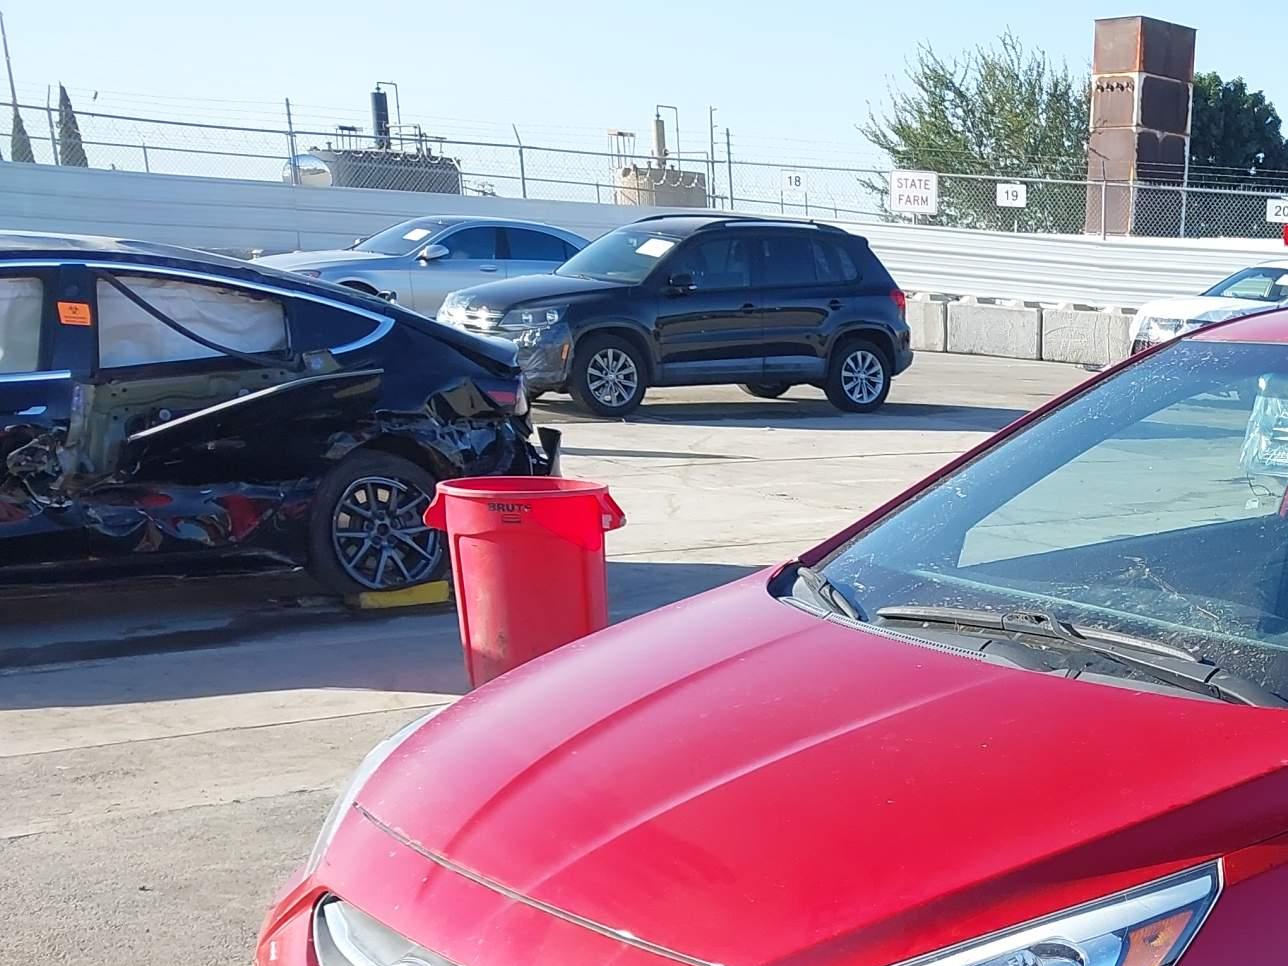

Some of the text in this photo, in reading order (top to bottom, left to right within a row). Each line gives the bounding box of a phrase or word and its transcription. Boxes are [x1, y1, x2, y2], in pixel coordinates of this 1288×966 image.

[788, 175, 801, 187] 18
[896, 178, 930, 190] STATE
[898, 194, 929, 206] FARM
[1004, 189, 1019, 201] 19
